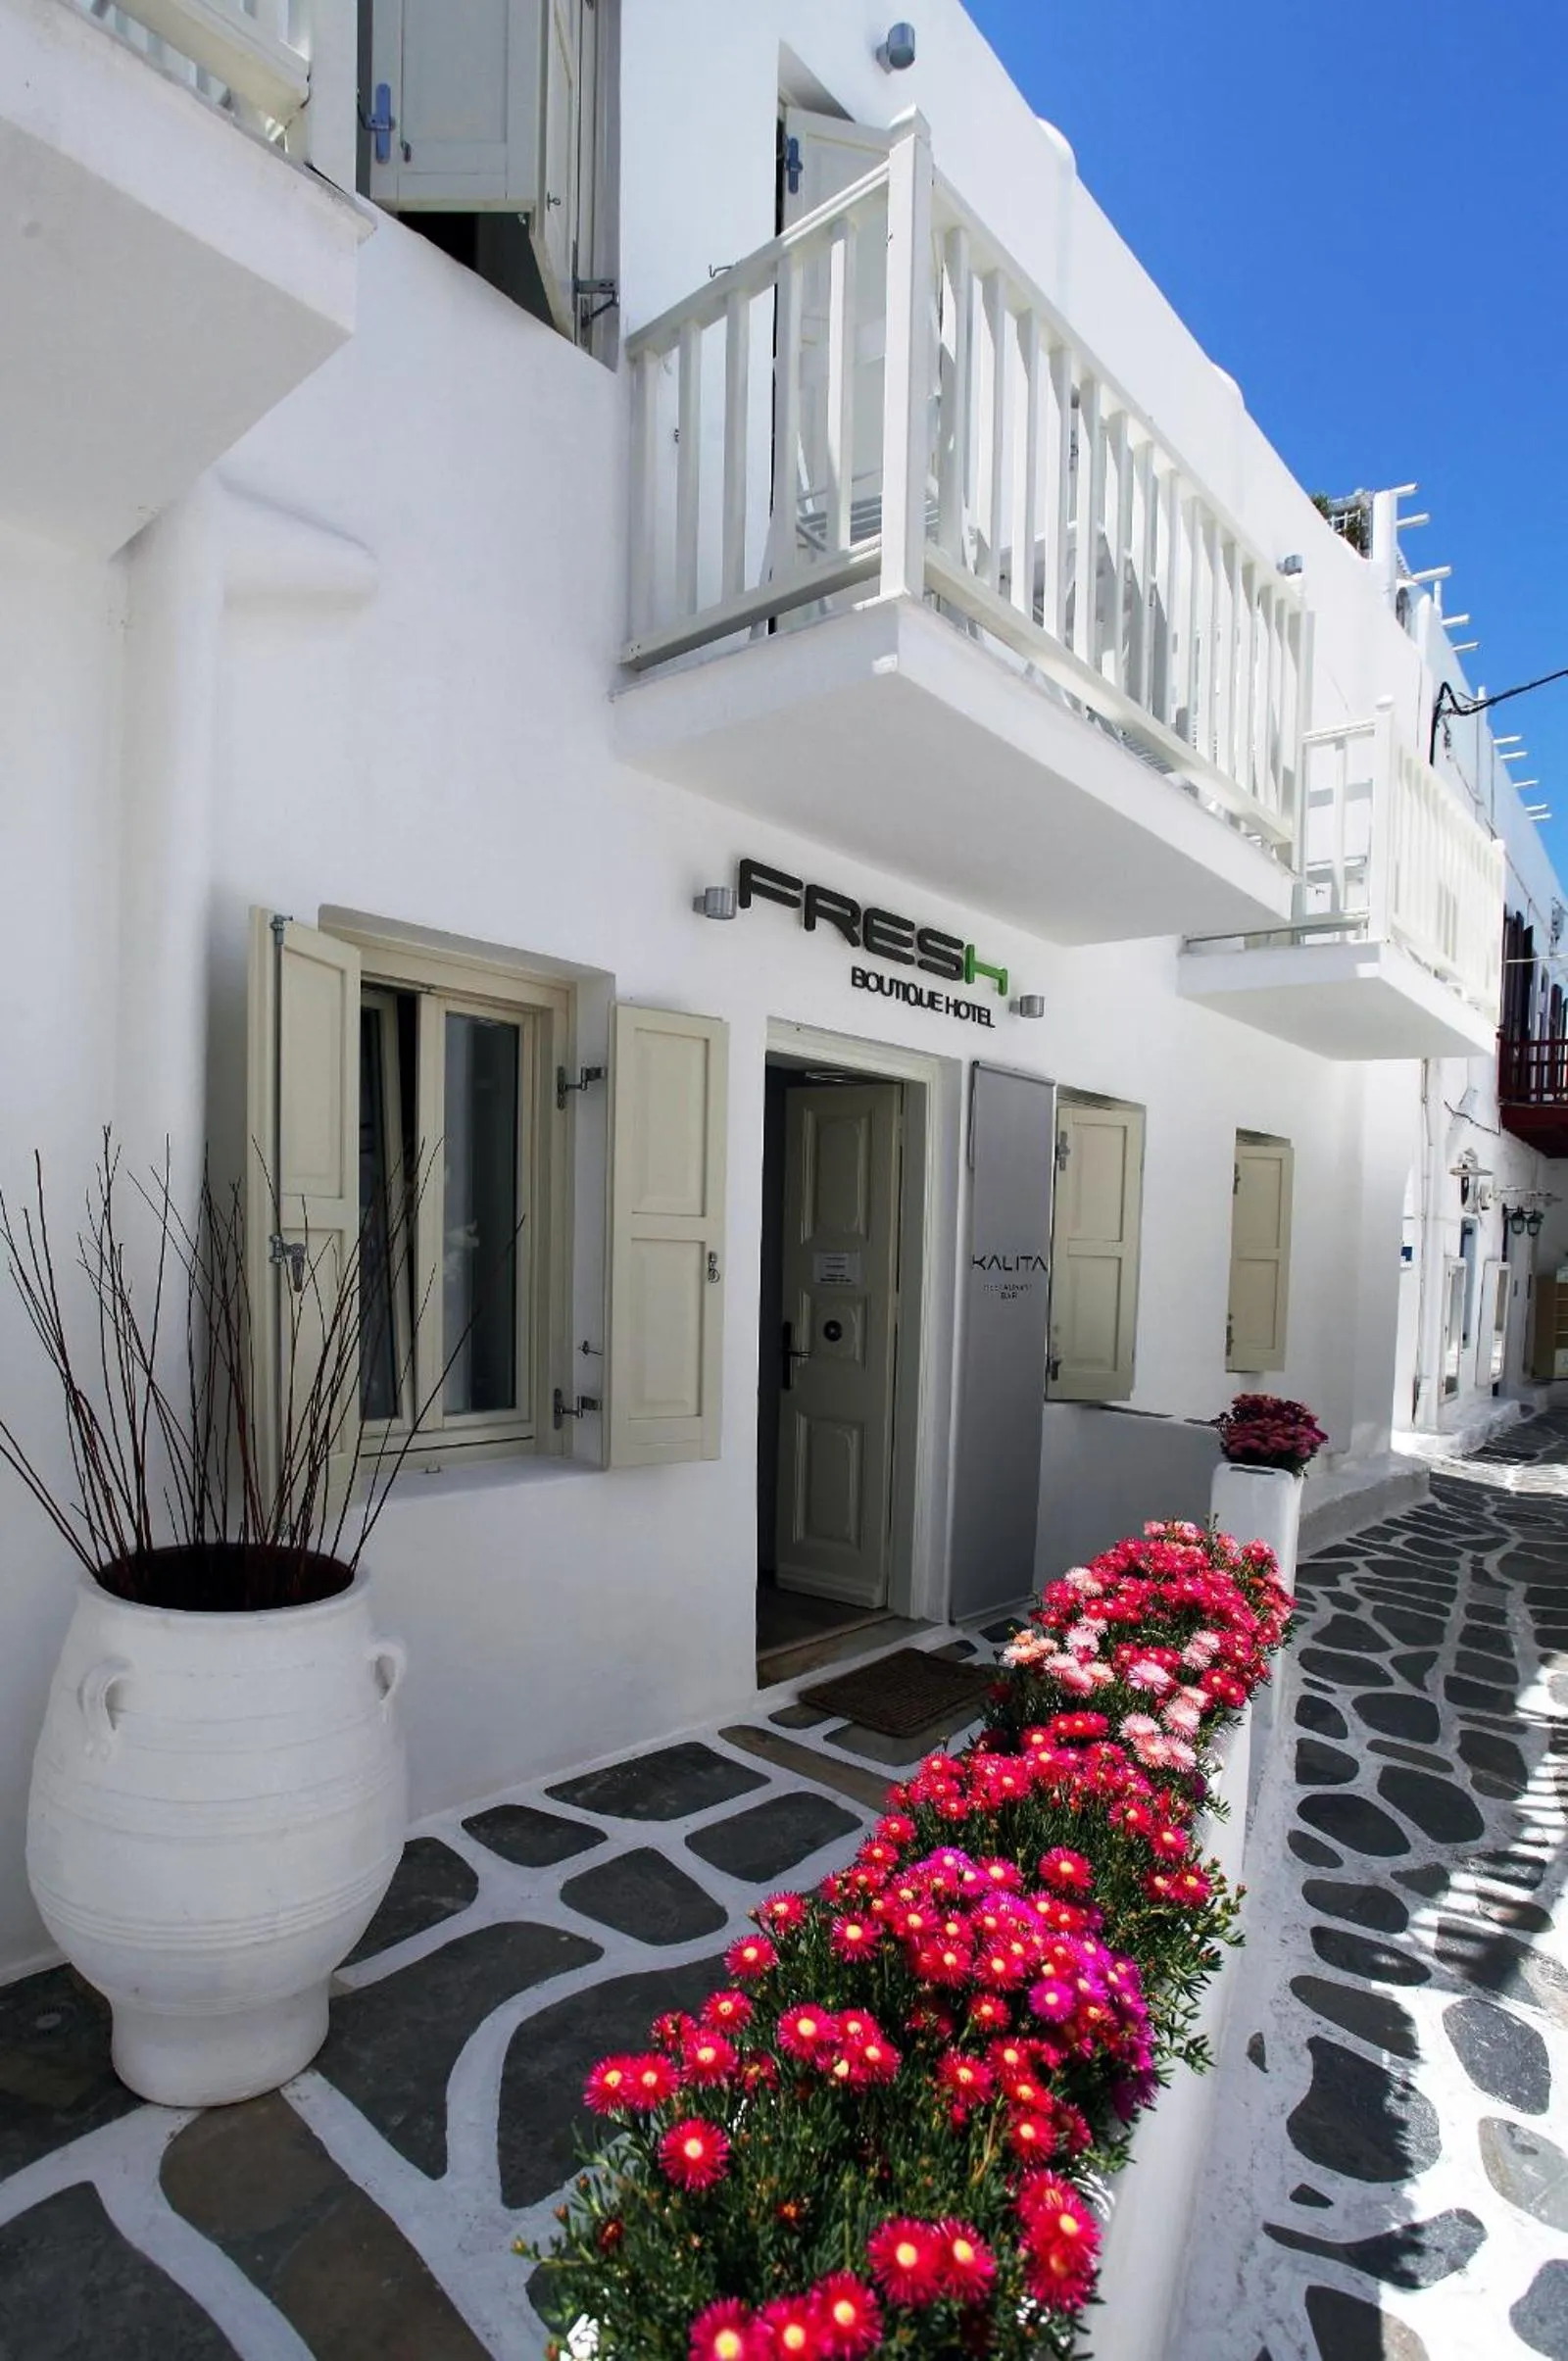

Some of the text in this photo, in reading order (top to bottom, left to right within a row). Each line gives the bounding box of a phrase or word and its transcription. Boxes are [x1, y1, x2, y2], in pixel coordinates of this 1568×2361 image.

[851, 966, 996, 1028] BOUTIQUE HOTEL
[972, 1254, 1048, 1271] KALITA
